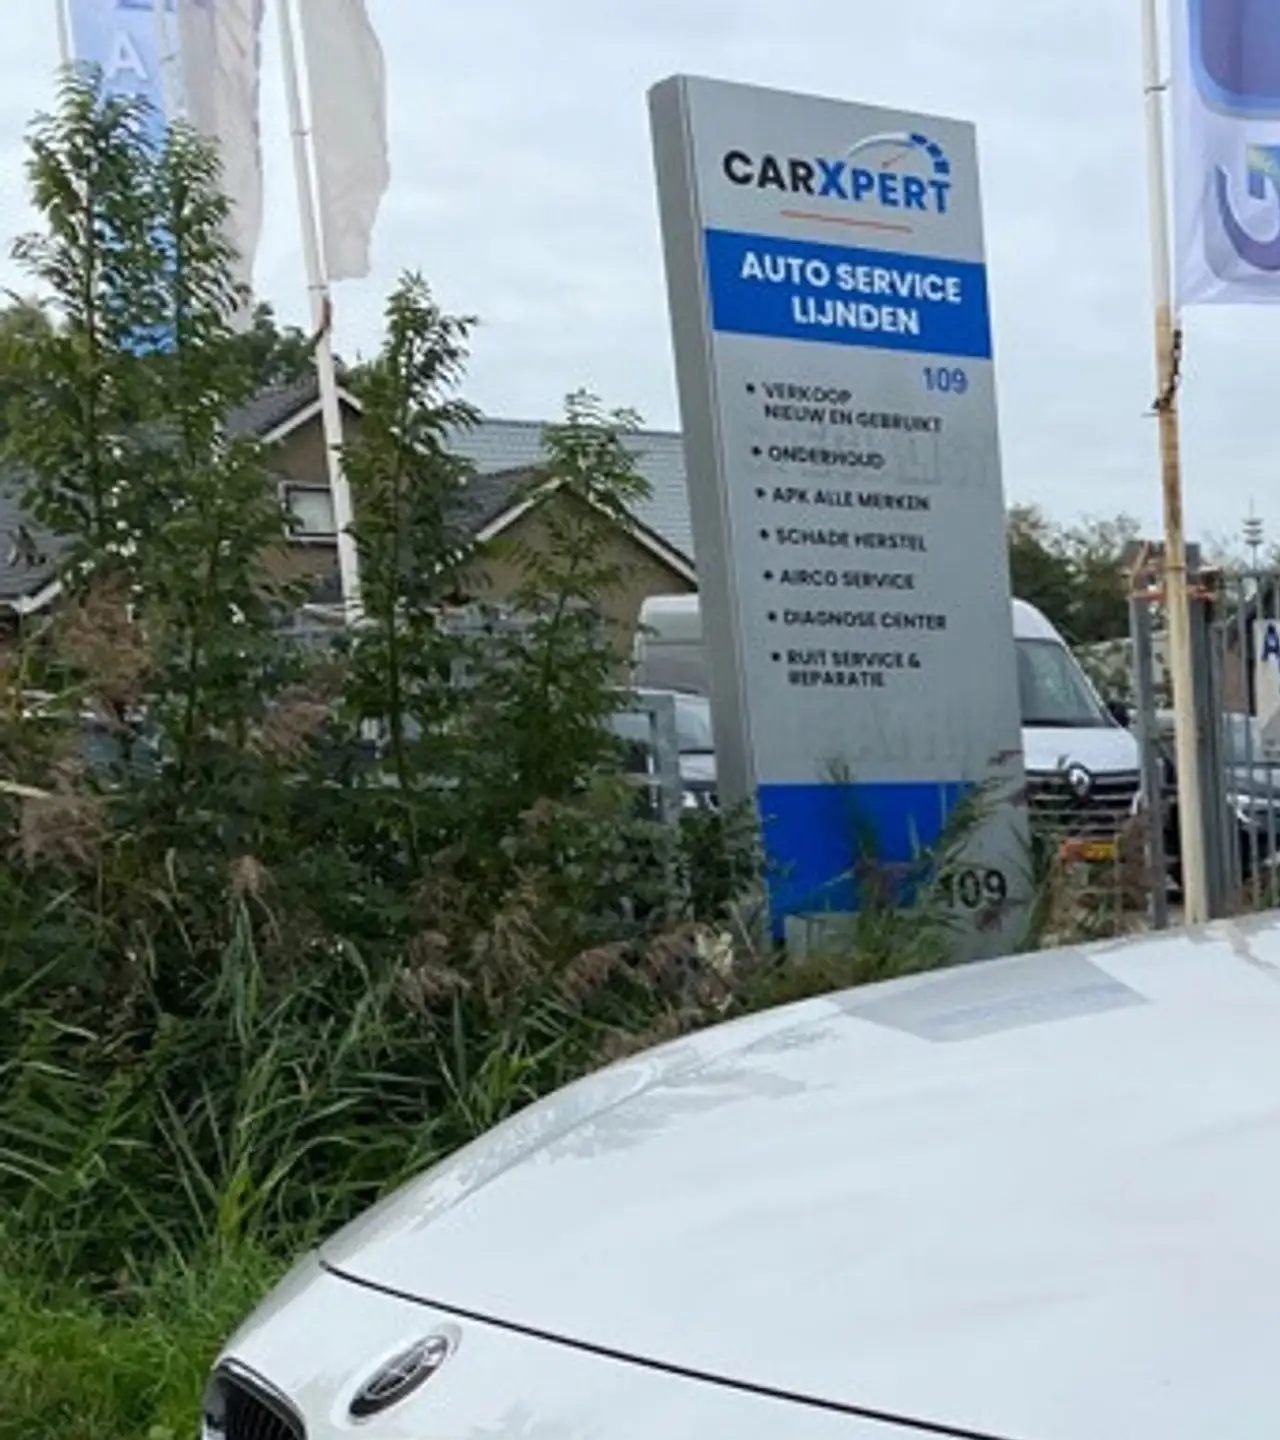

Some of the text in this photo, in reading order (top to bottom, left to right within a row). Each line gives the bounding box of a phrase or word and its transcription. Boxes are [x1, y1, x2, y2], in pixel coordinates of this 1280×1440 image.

[722, 149, 952, 214] CARXPERT
[740, 251, 963, 304] AUTO SERVICE
[790, 296, 920, 335] LIJNDEN
[922, 366, 969, 395] 109
[764, 404, 826, 424] NIEUW
[829, 407, 853, 425] EN
[767, 445, 886, 470] ONDERHOUD
[772, 487, 809, 503] APK
[814, 489, 853, 507] ALLE
[776, 527, 928, 552] SCHADE HERSTEL
[780, 568, 916, 590] AIRCO SERVICE
[783, 608, 947, 630] DIAGNOSE CENTER
[787, 649, 827, 666] RUIT
[831, 651, 904, 669] SERVICE
[787, 670, 886, 688] REPARATIE
[938, 868, 1007, 910] 109
